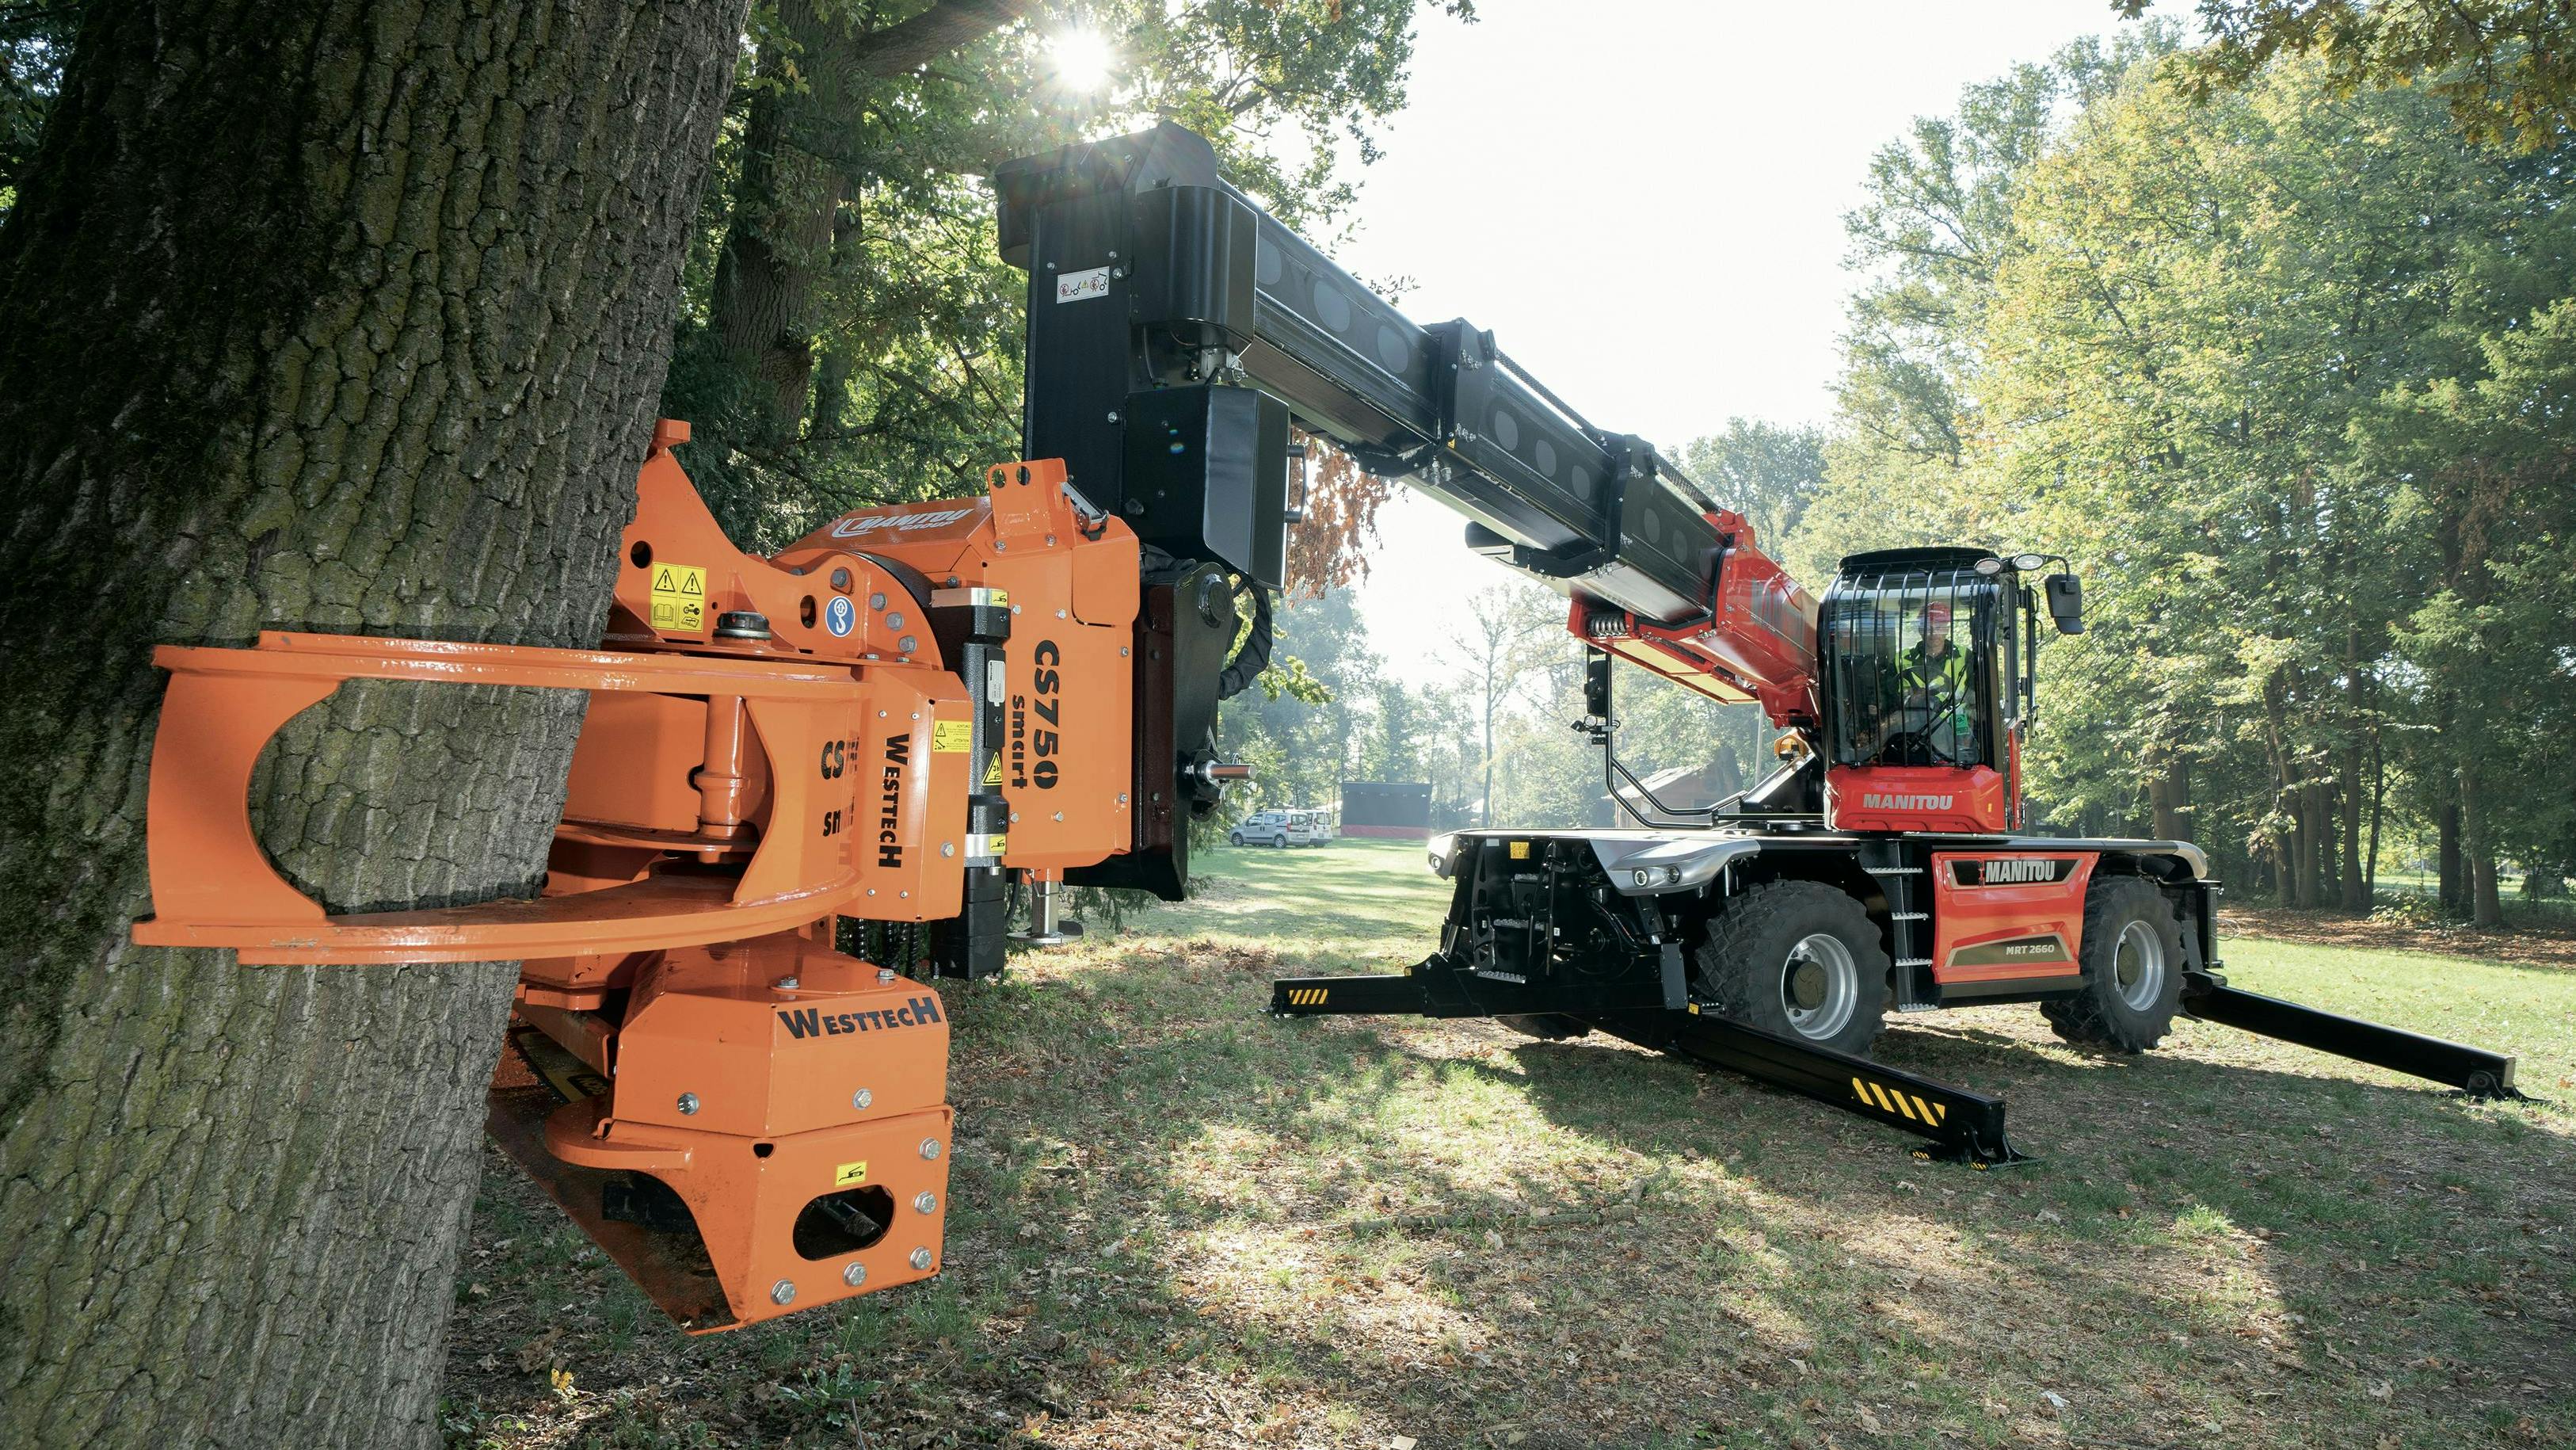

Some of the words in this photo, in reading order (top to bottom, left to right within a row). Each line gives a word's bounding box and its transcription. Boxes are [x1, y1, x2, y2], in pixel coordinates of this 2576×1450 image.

[852, 509, 974, 530] MANITOU
[1034, 639, 1060, 789] CS750
[1012, 694, 1027, 789] smart
[1863, 793, 1953, 810] MANITOU
[1985, 860, 2056, 883] MANITOU
[2006, 945, 2029, 955] MRT
[2029, 944, 2055, 953] 2660
